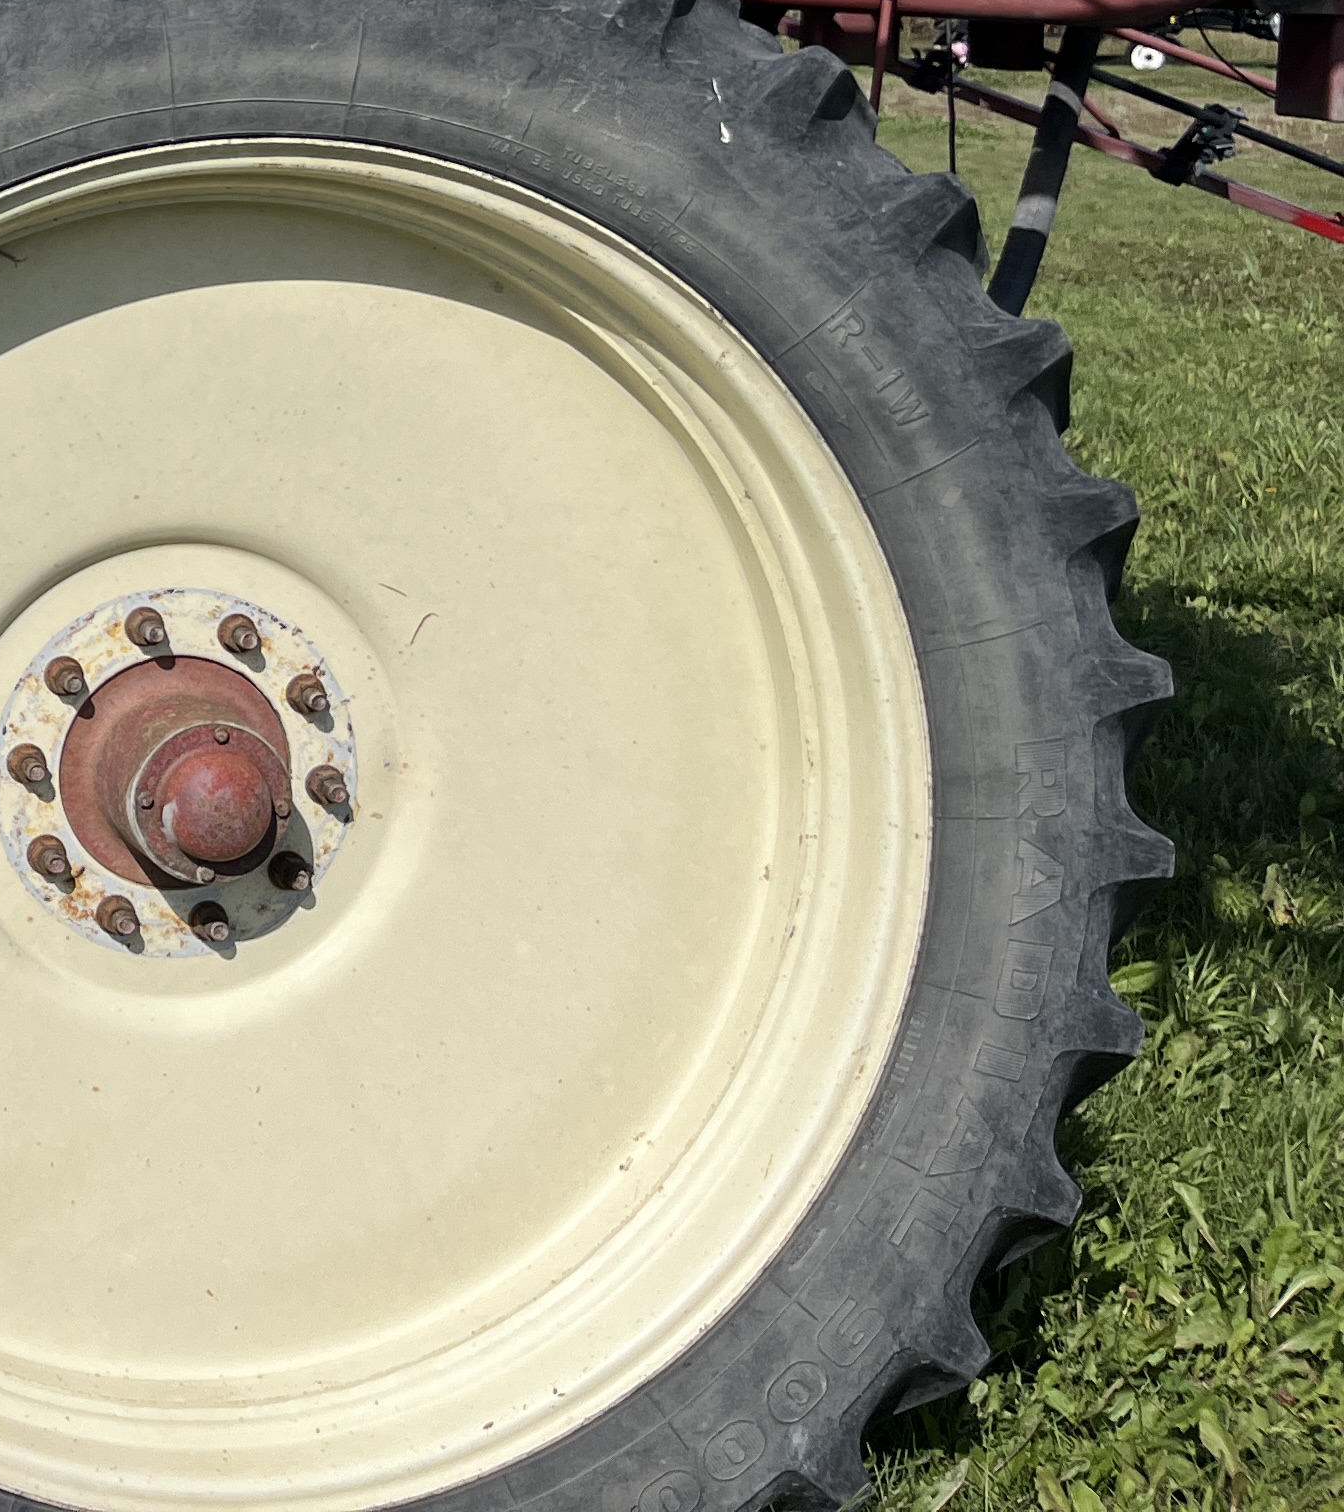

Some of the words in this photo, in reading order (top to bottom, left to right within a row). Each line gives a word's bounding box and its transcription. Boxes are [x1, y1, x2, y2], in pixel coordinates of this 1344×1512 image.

[488, 137, 523, 160] MAY
[657, 220, 698, 254] TYPE
[562, 146, 647, 198] TUBELESS
[890, 739, 1066, 1245] RADIAL
